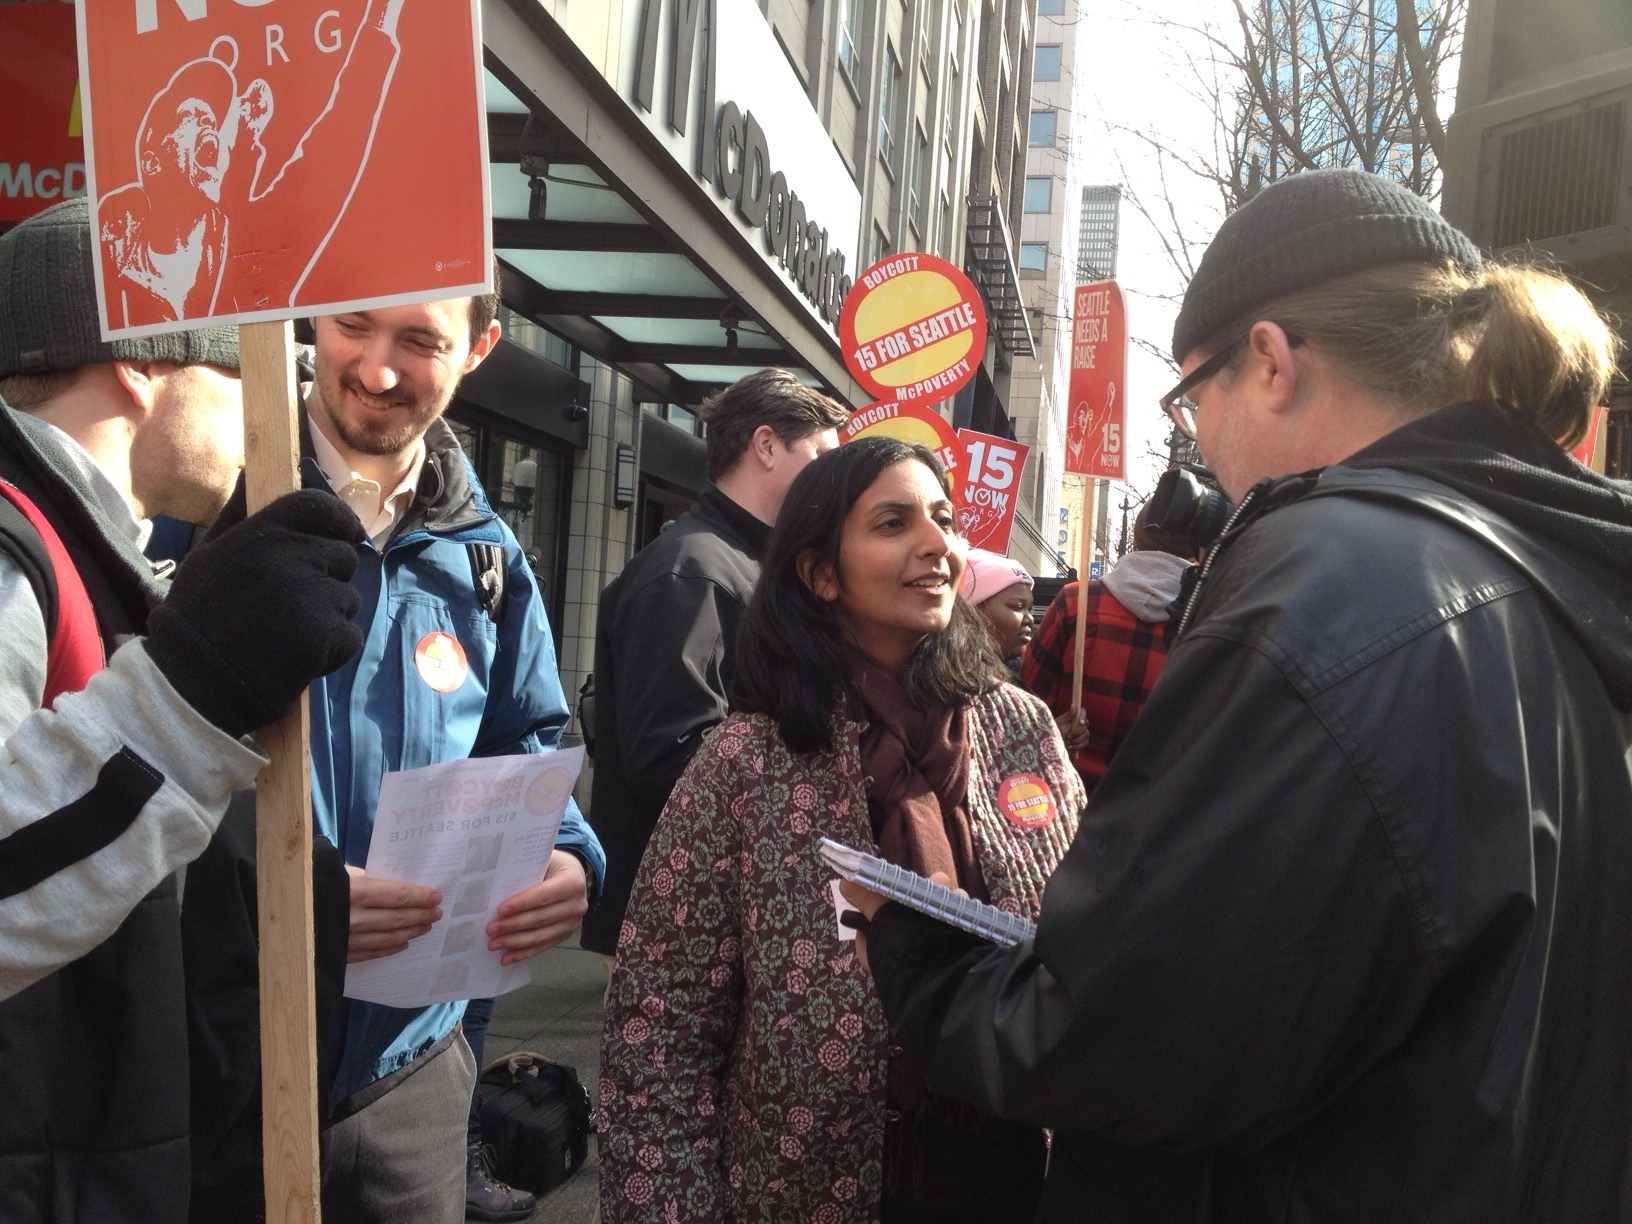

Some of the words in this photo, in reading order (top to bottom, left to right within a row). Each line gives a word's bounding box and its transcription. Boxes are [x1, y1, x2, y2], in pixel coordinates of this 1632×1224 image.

[863, 256, 919, 290] BOYCOTT
[1077, 290, 1110, 317] SEATTLE
[854, 345, 878, 372] 15
[875, 331, 912, 363] FOR
[908, 302, 977, 348] SEATTLE
[1075, 318, 1100, 343] NEEDS
[1101, 317, 1108, 342] A
[1074, 345, 1096, 369] RAISE
[895, 358, 971, 401] McPOVERTY
[847, 402, 900, 437] BOYCOTT
[1102, 422, 1120, 453] 15
[966, 441, 1017, 490] 15
[1101, 453, 1120, 468] NOW
[964, 485, 1009, 510] NOW
